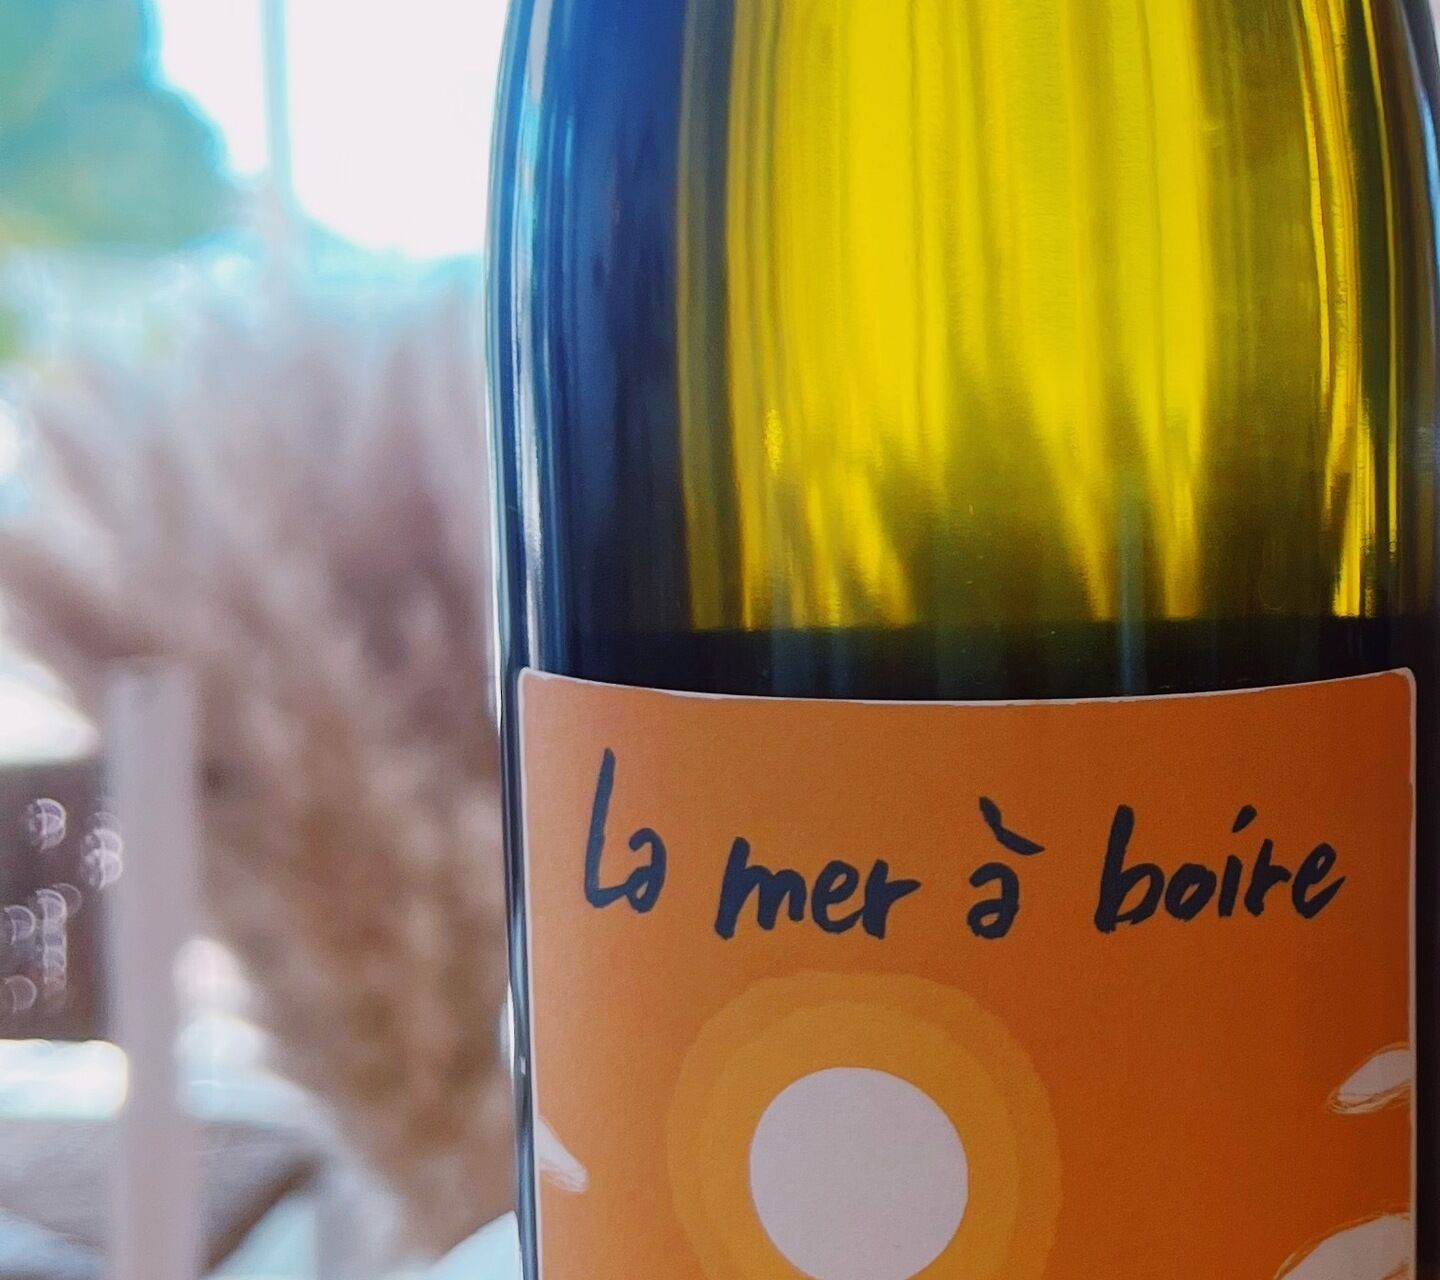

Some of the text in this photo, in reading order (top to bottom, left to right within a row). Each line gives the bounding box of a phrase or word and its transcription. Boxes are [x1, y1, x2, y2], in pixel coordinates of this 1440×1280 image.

[714, 837, 922, 940] mer
[967, 796, 1046, 939] à
[1094, 804, 1347, 934] boire
